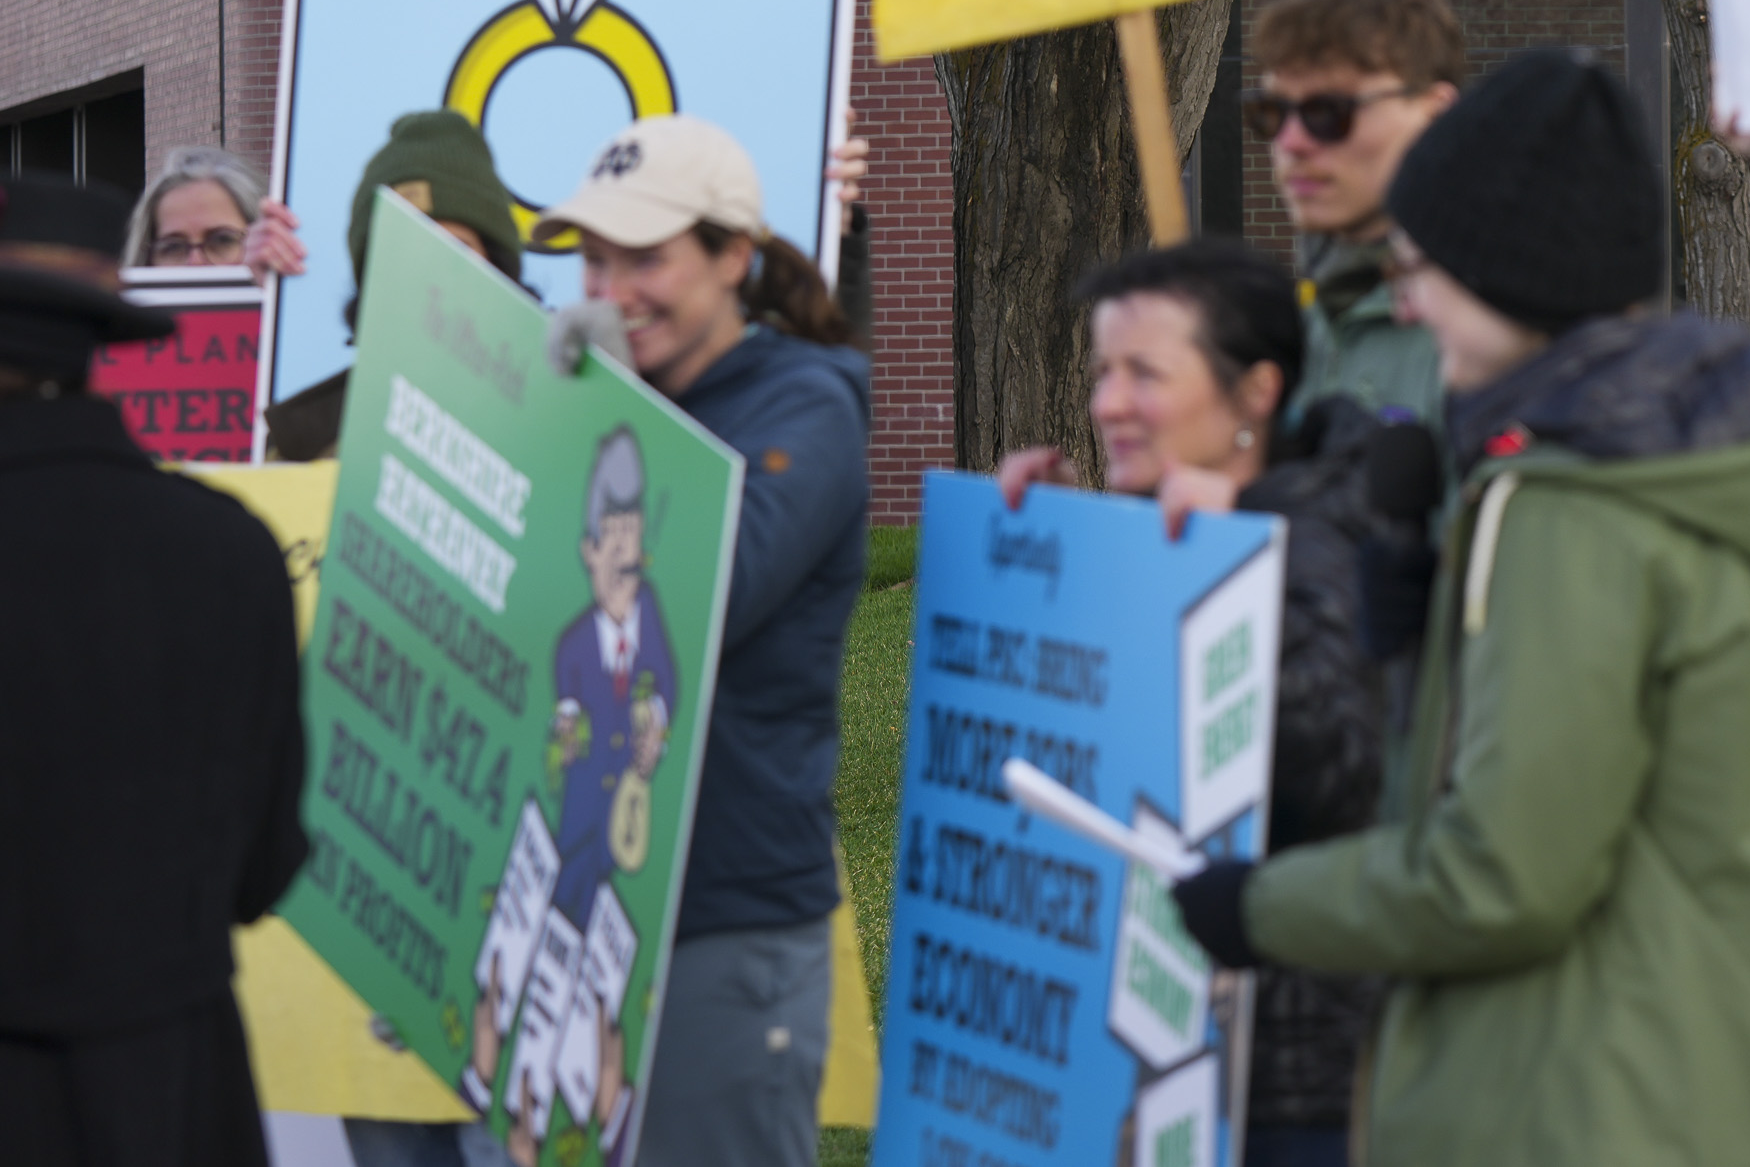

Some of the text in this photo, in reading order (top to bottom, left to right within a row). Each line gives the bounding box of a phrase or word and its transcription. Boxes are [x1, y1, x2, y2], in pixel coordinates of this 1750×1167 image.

[384, 373, 532, 540] BERKSHIRE
[323, 597, 425, 742] EARN
[339, 509, 530, 719] SHAREHOLDERS
[323, 718, 475, 919] BILLION
[924, 702, 1017, 806] MORE
[340, 856, 448, 1002] PROFITS
[933, 822, 1102, 953] STRONGER
[909, 931, 1080, 1068] ECONOMY
